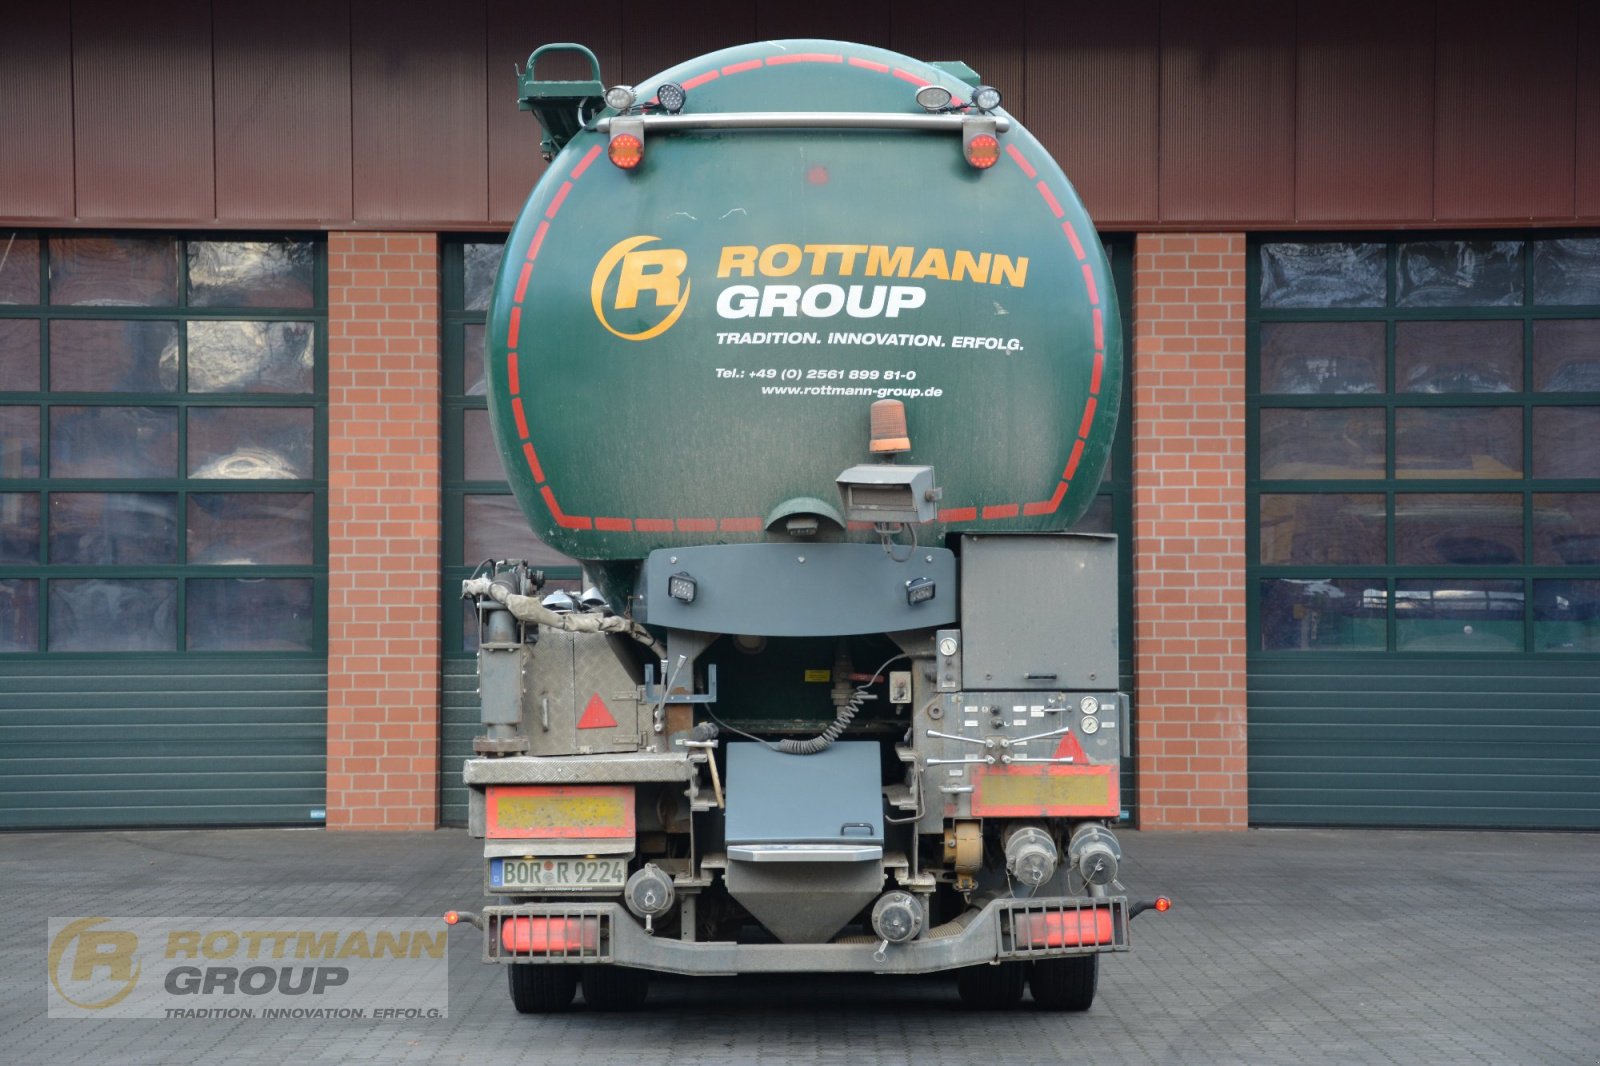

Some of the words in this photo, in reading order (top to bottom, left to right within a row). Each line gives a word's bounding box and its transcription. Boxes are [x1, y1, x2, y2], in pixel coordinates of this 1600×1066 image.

[716, 243, 1029, 287] ROTTMANN
[716, 284, 926, 319] GROUP
[716, 332, 821, 345] TRADITION.
[827, 332, 946, 348] INNOVATION.
[951, 336, 1024, 351] ERFOLG.
[715, 368, 745, 379] Tel.:
[748, 368, 777, 379] +49
[781, 368, 802, 380] (0)
[806, 369, 845, 379] 2561
[848, 370, 879, 380] 899
[883, 371, 917, 381] 81-0
[761, 385, 943, 398] www.rottmann-group.de
[504, 862, 541, 883] BOR
[557, 862, 570, 883] R
[574, 861, 622, 882] 9224
